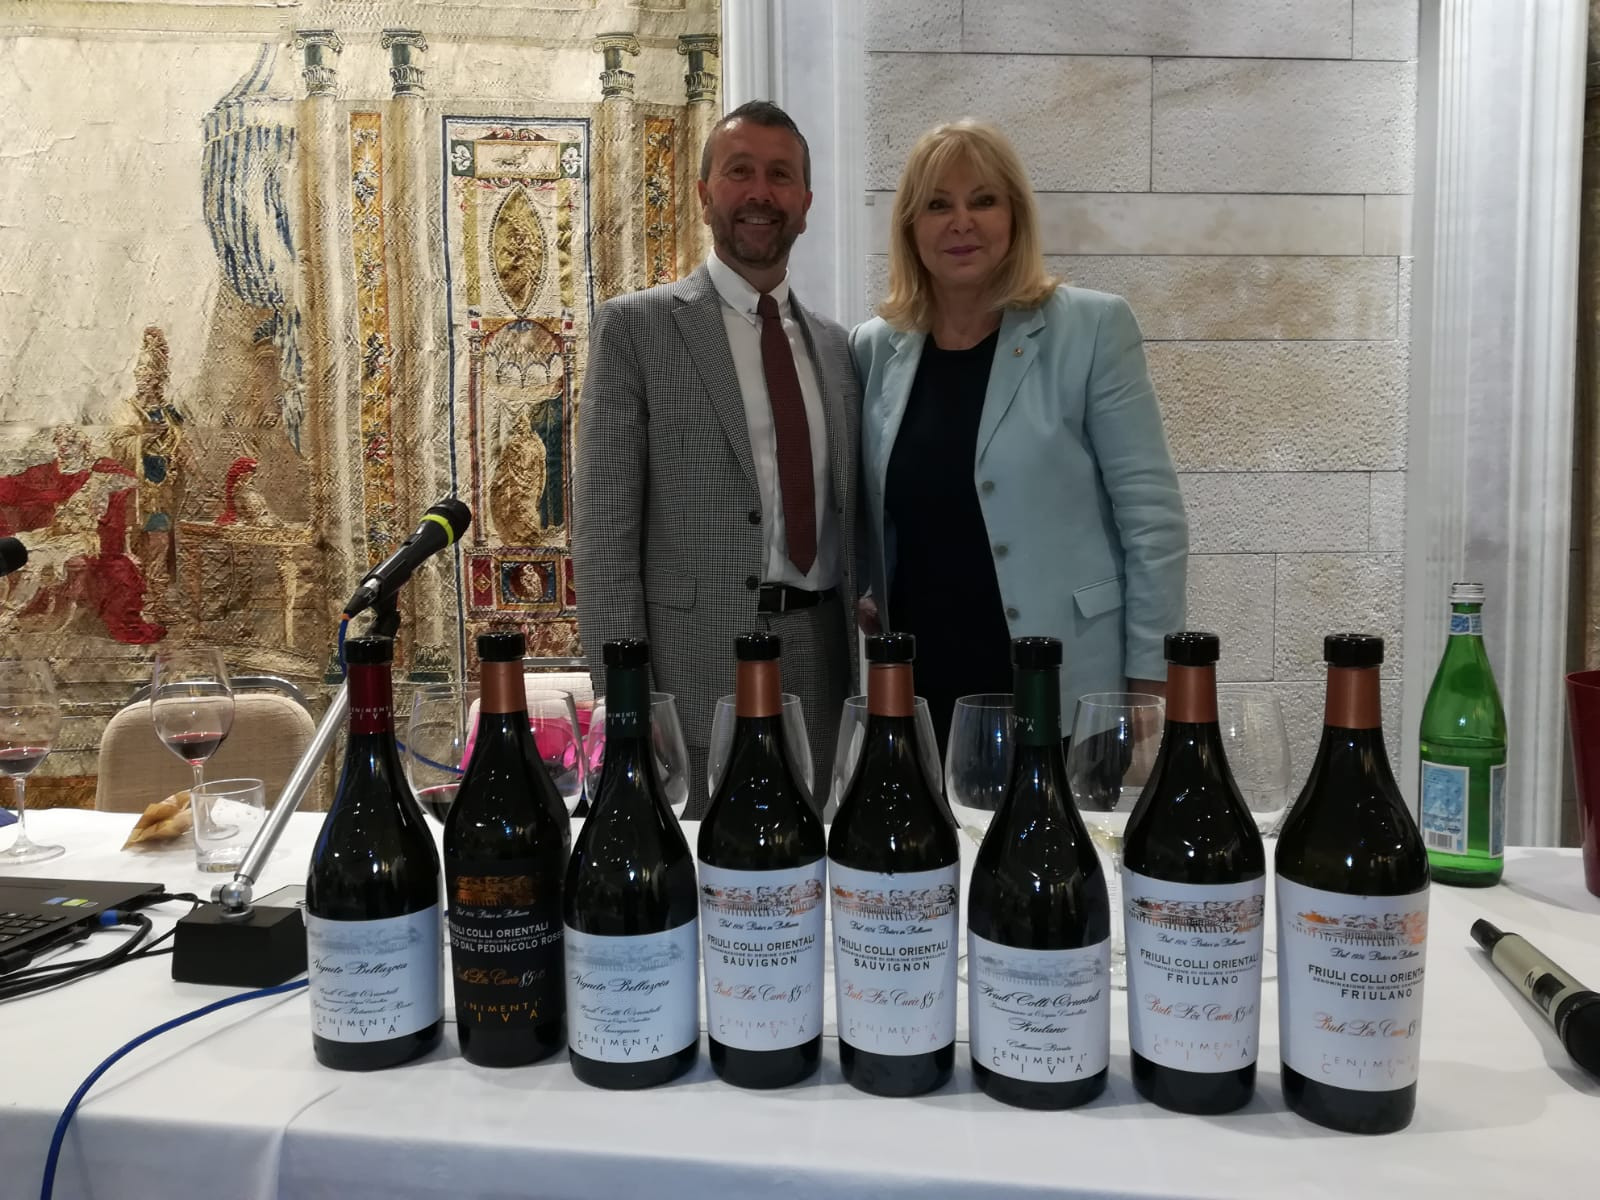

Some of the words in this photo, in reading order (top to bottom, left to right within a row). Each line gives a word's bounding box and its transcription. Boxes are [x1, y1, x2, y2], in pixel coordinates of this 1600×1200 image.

[466, 928, 493, 938] COLLI
[496, 921, 549, 938] ORIENTALI
[461, 942, 475, 952] DAL
[478, 940, 538, 953] PEDUNCOLO
[707, 934, 731, 949] FRIULI
[733, 941, 763, 952] COLLI
[767, 934, 815, 951] ORIENTALI
[838, 936, 862, 951] FRIULI
[865, 945, 895, 956] COLLI
[899, 940, 949, 956] ORIENTALI
[723, 955, 798, 967] SAUVIGNON
[854, 958, 931, 972] SAUVIGNON
[1140, 948, 1171, 965] FRIULI
[1174, 958, 1209, 969] COLLI
[1213, 952, 1259, 969] ORIENTALI
[1167, 973, 1239, 986] FRIULANO
[1308, 964, 1346, 981] FRIULI
[1350, 973, 1386, 984] COLLI
[1390, 967, 1425, 983] ORIENTA
[1341, 988, 1413, 1000] FRIULANO
[478, 1009, 538, 1022] IVA
[992, 1056, 1083, 1075] CIVA
